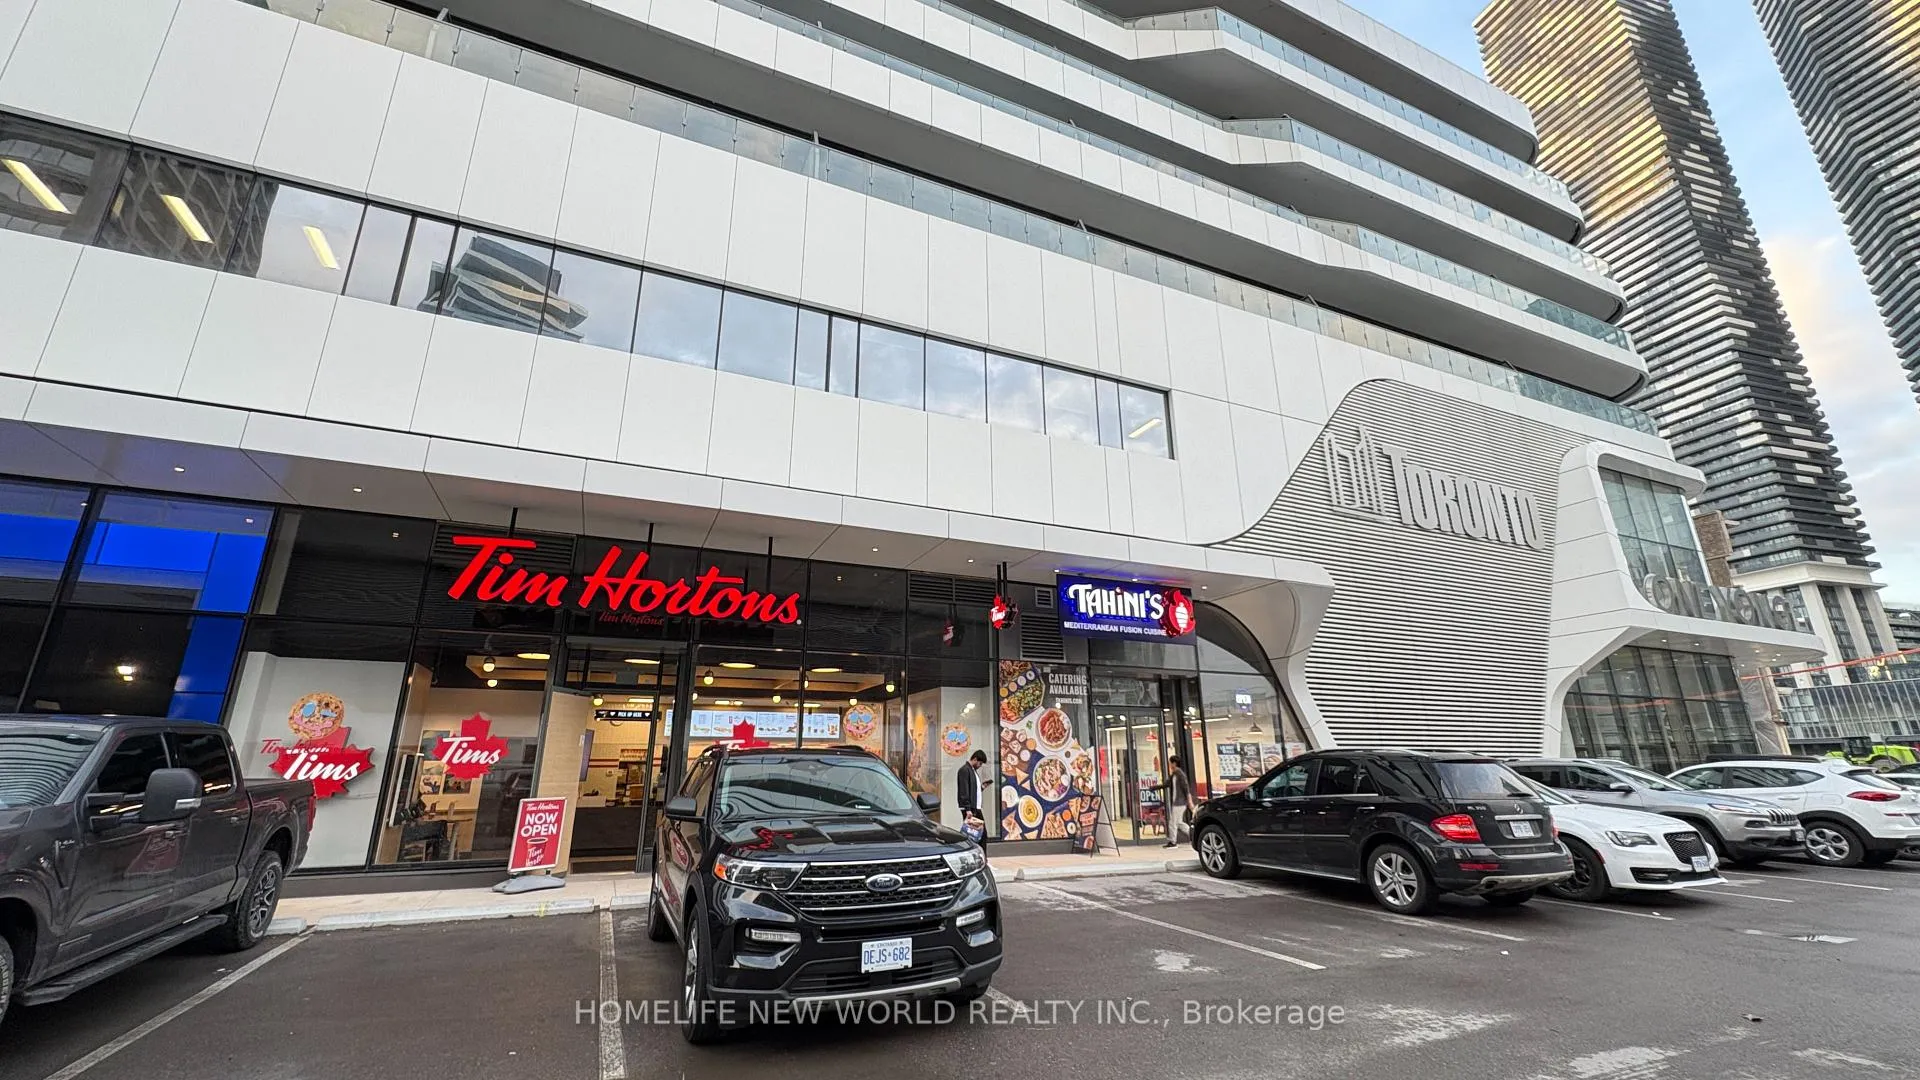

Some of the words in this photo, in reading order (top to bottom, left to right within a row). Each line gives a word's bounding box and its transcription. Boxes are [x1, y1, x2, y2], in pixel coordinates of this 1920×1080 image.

[1383, 445, 1546, 550] TORONTO
[448, 535, 569, 607] Tim
[578, 545, 801, 624] Hortons
[1063, 621, 1119, 632] MEDITERRANEAN
[1120, 625, 1142, 634] FUSION
[1143, 628, 1167, 636] CUISINE
[1048, 673, 1087, 685] CATERING
[1049, 685, 1088, 696] AVAILABLE
[443, 736, 501, 764] Tims
[283, 747, 361, 780] Tims
[1140, 777, 1158, 788] NOW
[1140, 790, 1161, 801] OPEN
[524, 812, 559, 825] NOW
[520, 823, 558, 838] OPEN
[893, 946, 911, 961] 682
